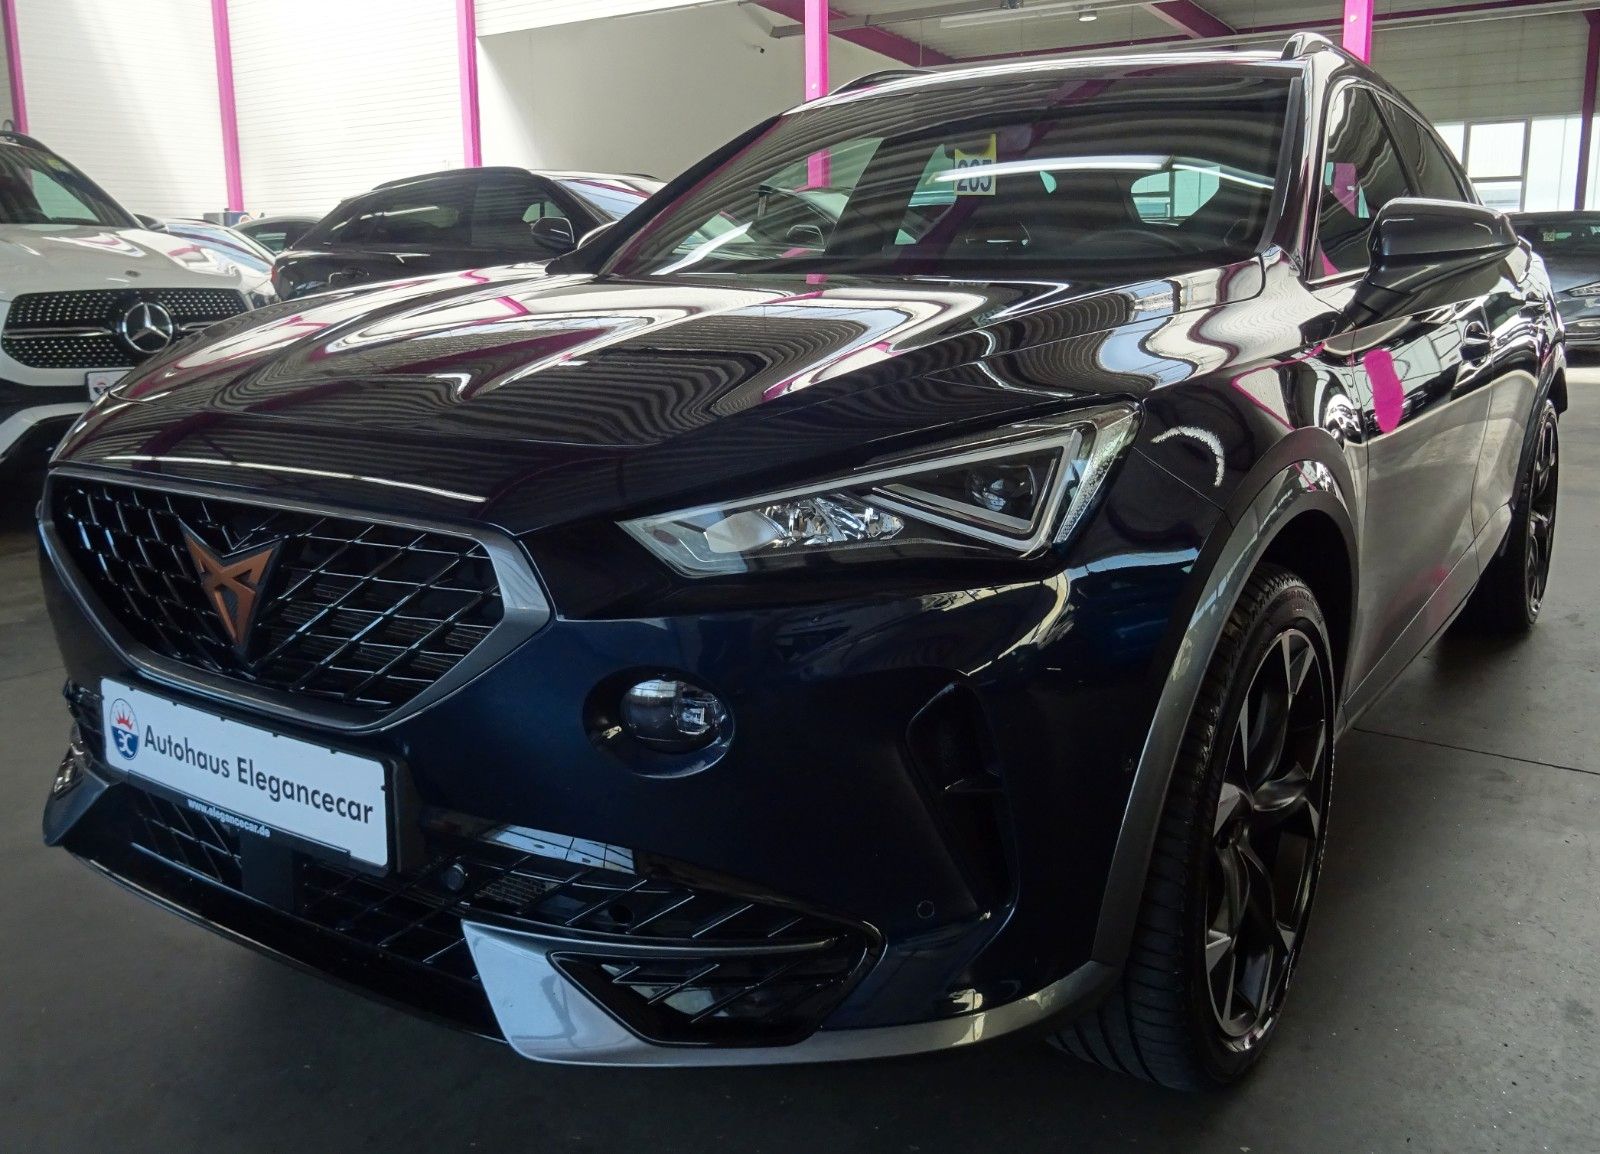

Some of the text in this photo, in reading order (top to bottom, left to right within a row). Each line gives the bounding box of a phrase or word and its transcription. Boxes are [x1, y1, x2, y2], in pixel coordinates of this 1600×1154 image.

[144, 725, 373, 823] Autohaus Elegancecar
[187, 799, 270, 837] www.elegancecar.de
